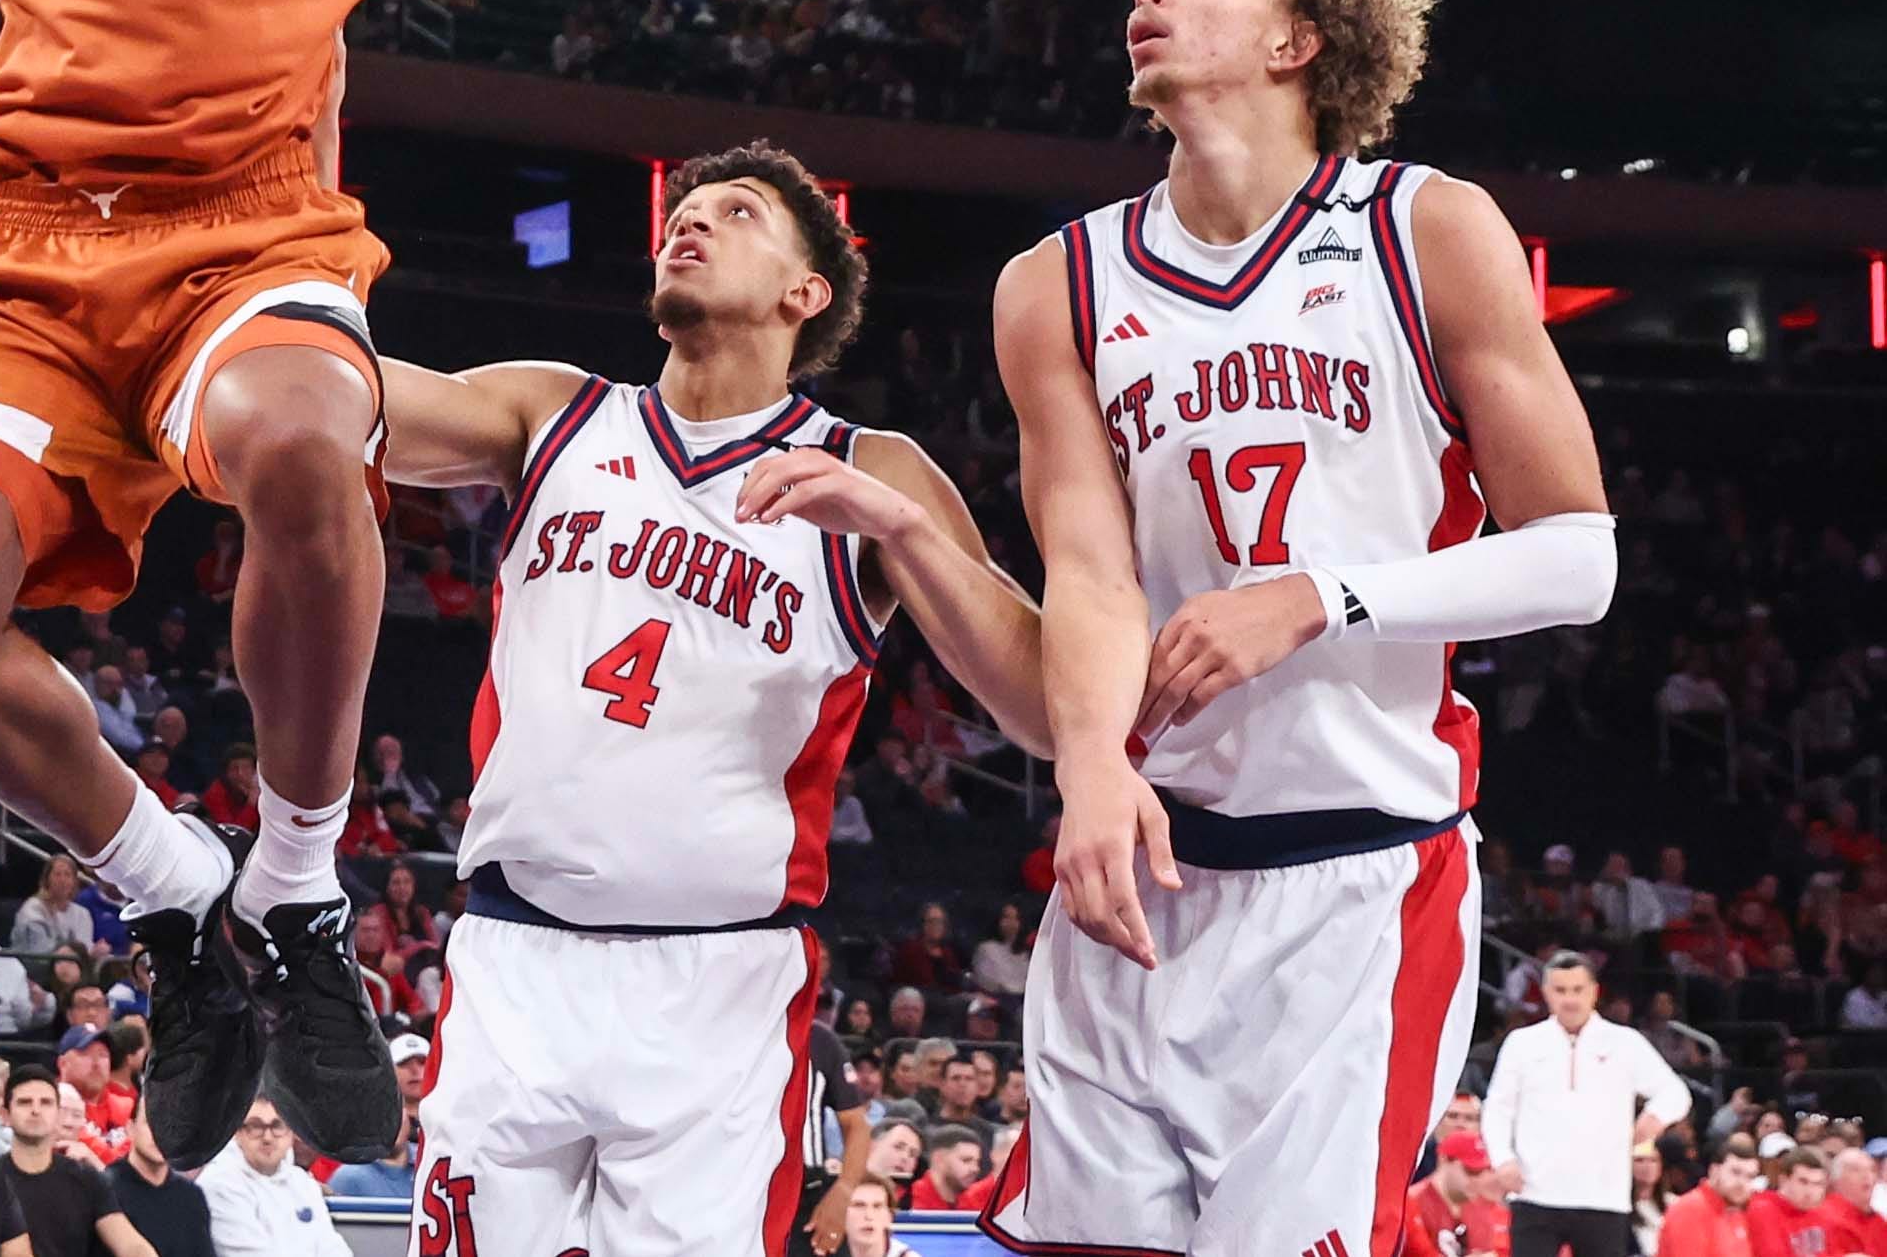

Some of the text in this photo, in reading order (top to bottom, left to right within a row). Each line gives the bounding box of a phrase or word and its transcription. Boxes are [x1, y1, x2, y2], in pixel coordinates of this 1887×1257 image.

[1105, 343, 1371, 484] ST. JOHN'S
[1188, 441, 1306, 567] 17
[523, 510, 804, 654] ST. JOHN'S
[581, 618, 672, 730] 4
